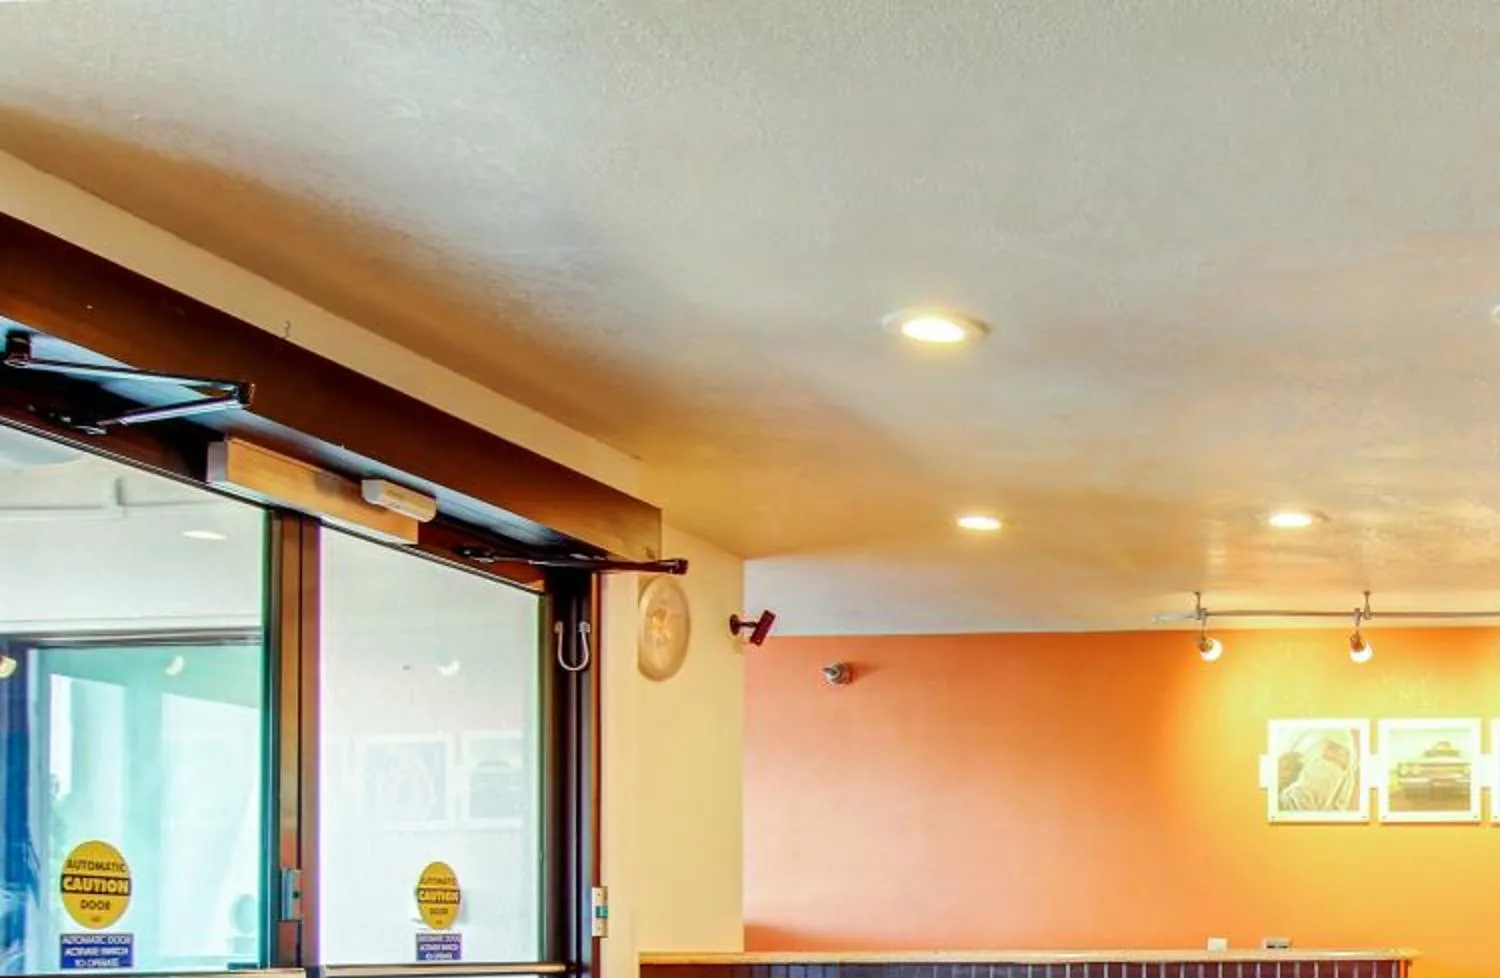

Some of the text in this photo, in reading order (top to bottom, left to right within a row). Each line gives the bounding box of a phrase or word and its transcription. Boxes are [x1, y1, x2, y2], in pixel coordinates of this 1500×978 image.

[66, 859, 128, 873] AUTOMATIC
[63, 876, 129, 893] CAUTION
[418, 889, 459, 902] CAUTION
[80, 899, 111, 910] DOOR
